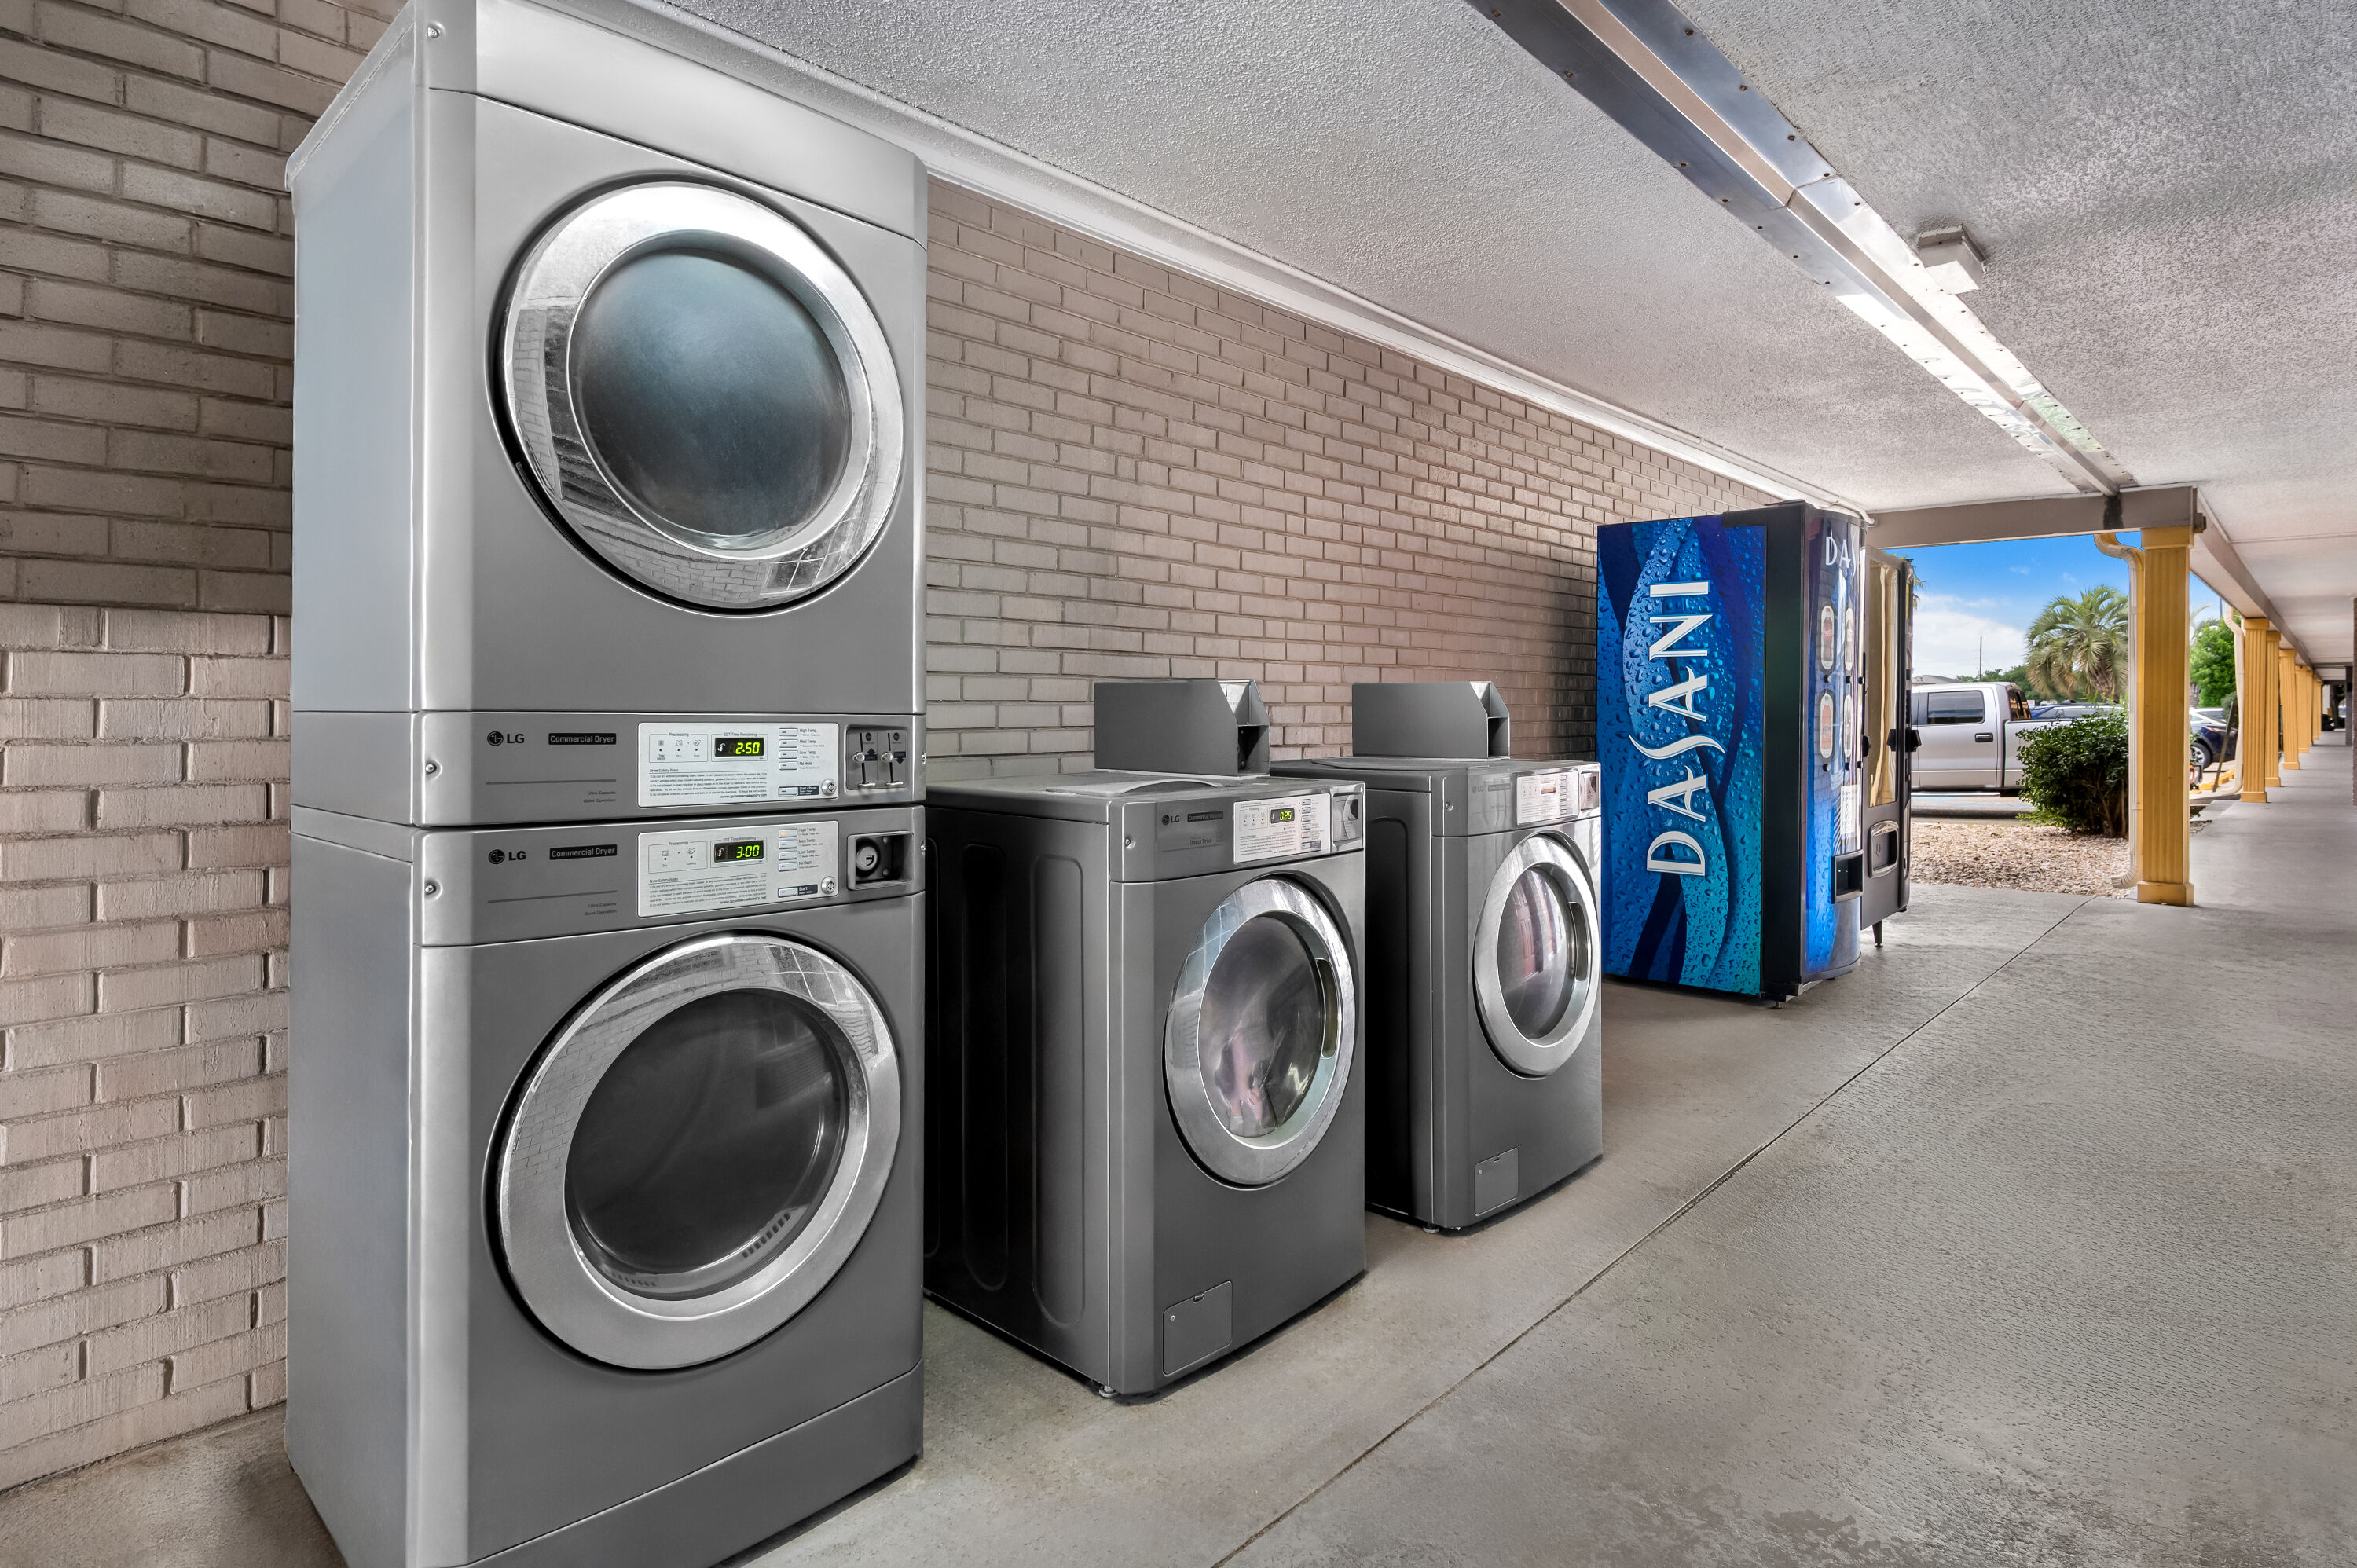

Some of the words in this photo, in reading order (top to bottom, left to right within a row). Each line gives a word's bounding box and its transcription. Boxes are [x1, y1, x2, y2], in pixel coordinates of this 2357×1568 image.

[1825, 533, 1860, 578] DAS
[1629, 581, 1726, 877] DASANI
[507, 734, 525, 744] LG
[595, 735, 614, 744] Dryer
[735, 742, 761, 755] 2.50
[508, 851, 526, 861] LG
[552, 848, 594, 858] Commercial
[735, 845, 761, 859] 3.00
